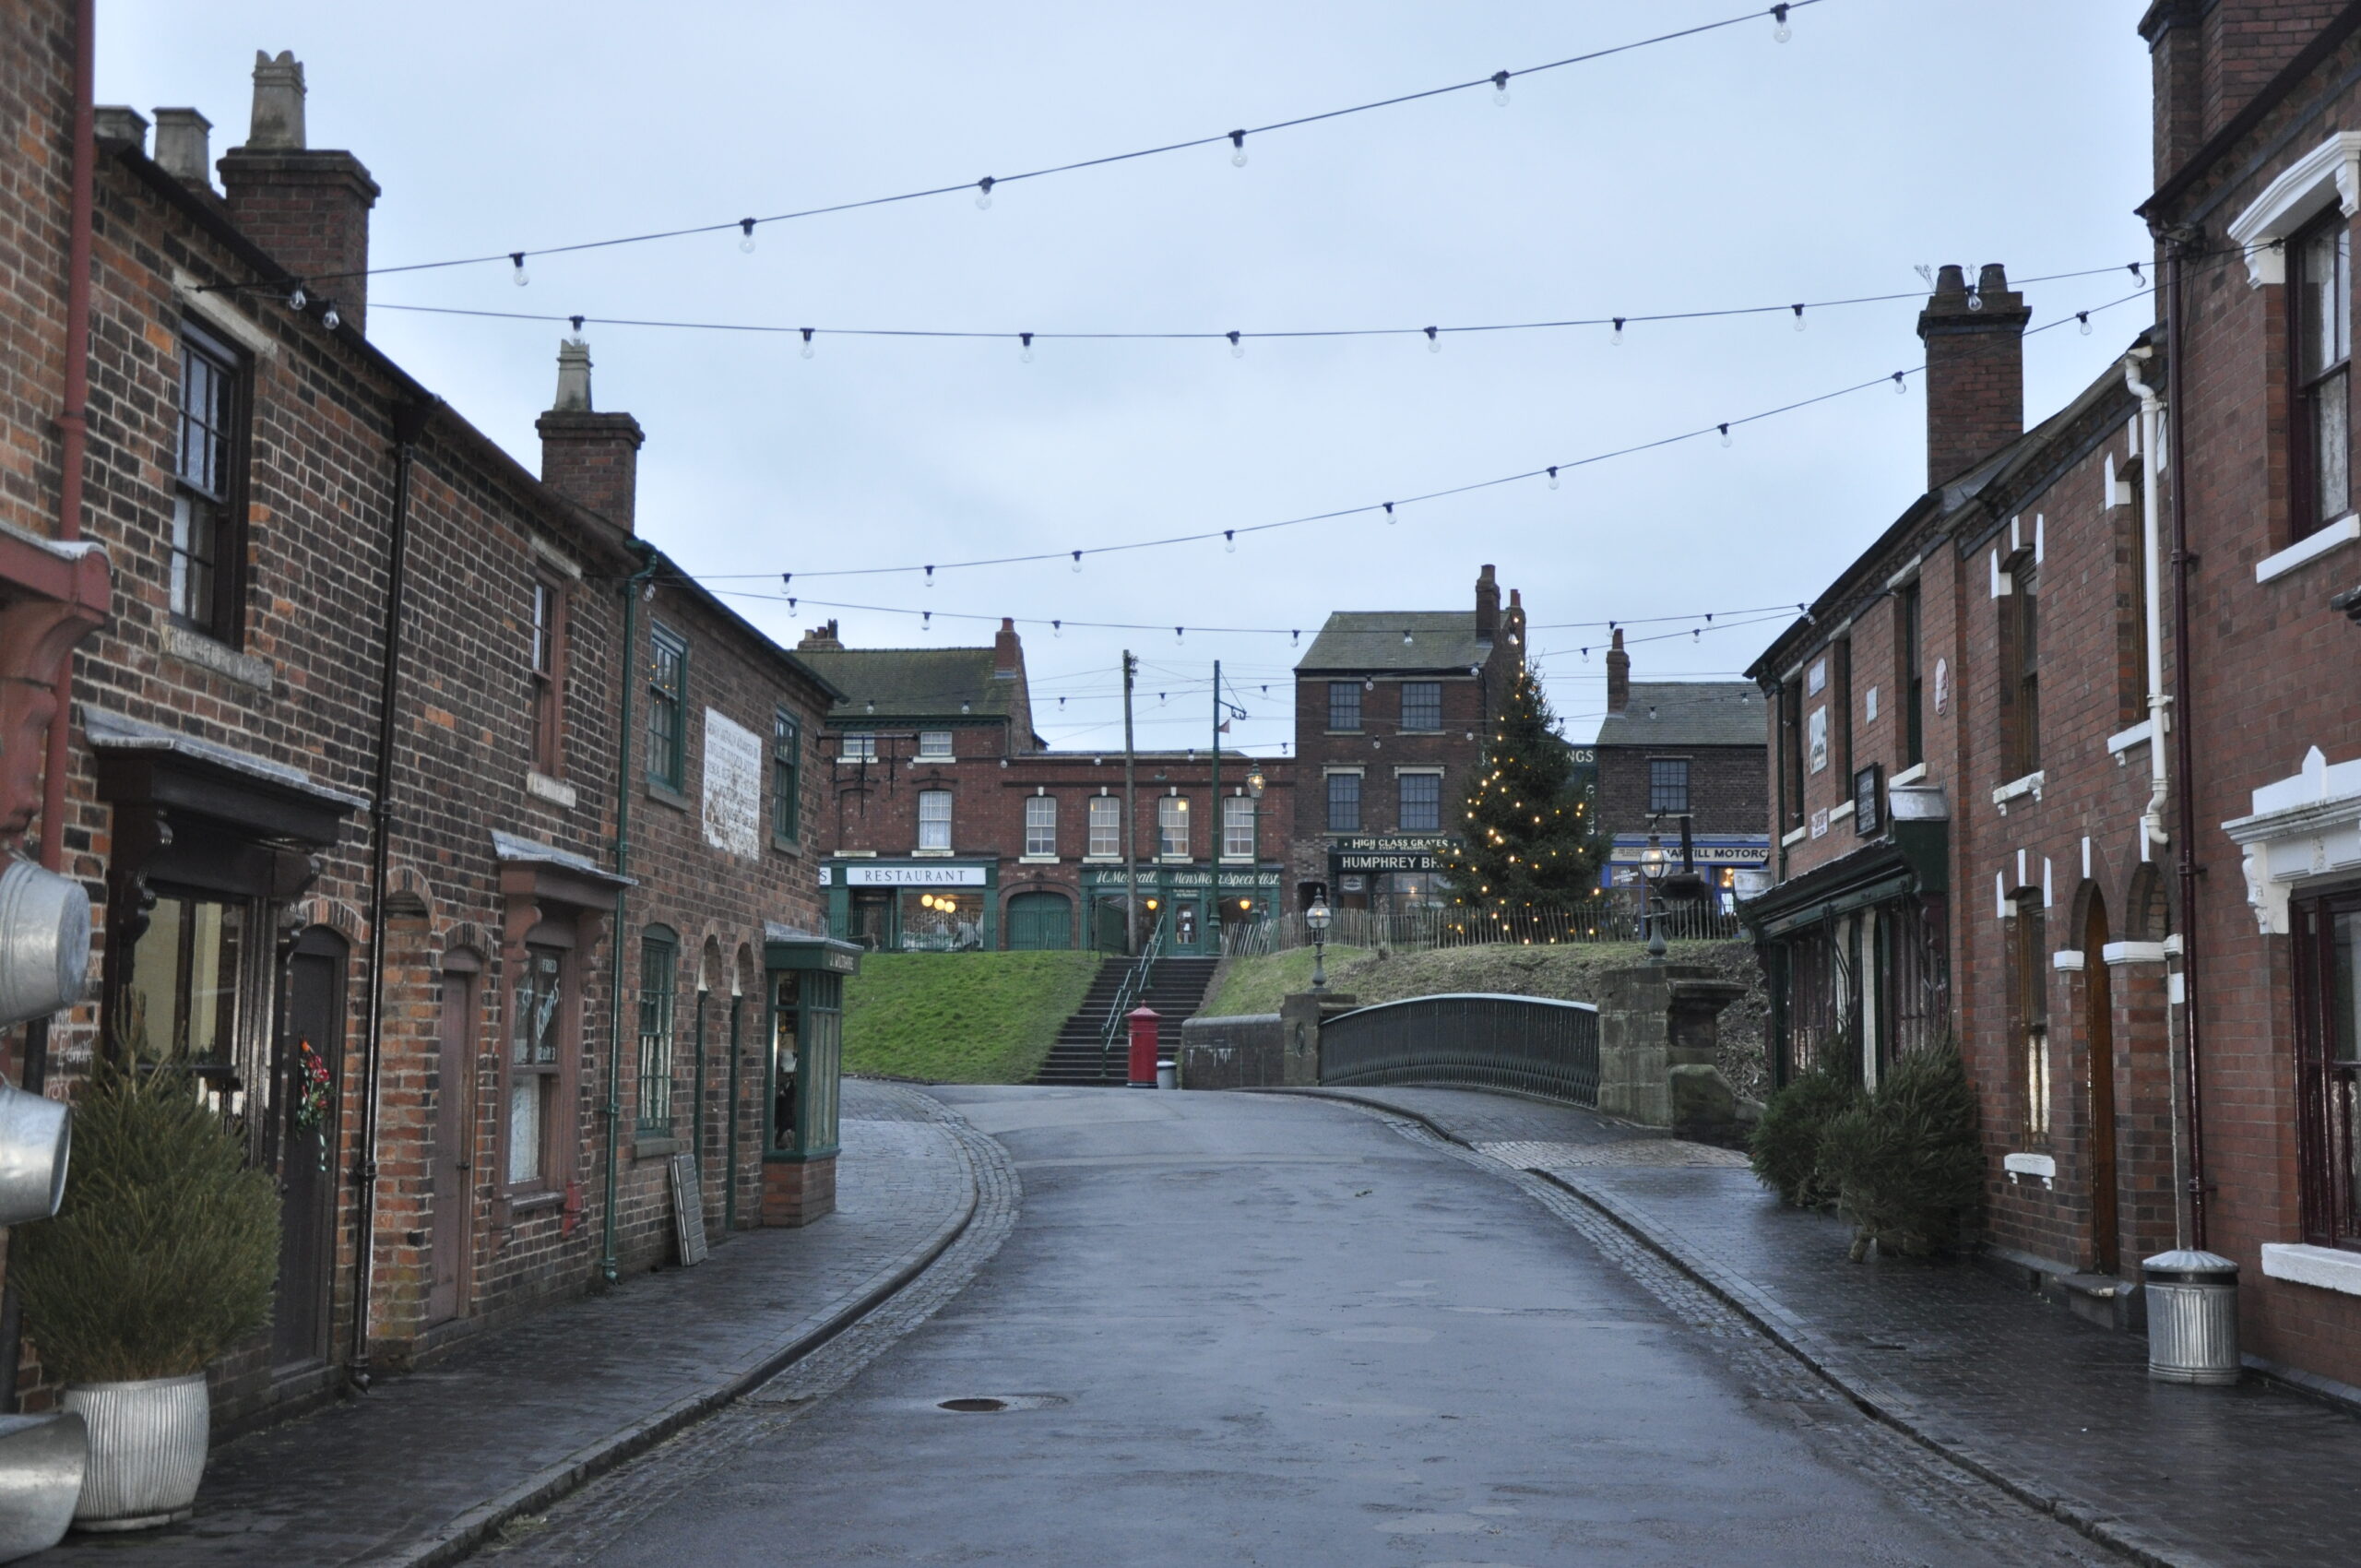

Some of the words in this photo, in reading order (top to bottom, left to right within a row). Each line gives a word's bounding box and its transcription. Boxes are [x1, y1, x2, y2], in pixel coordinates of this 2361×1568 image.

[1352, 838, 1376, 849] HIGH
[1379, 838, 1408, 847] CLASS
[1411, 838, 1449, 848] GRATES
[1714, 849, 1769, 858] MOTORC
[1343, 856, 1417, 868] HUMPHREY
[864, 870, 966, 882] RESTAURANT
